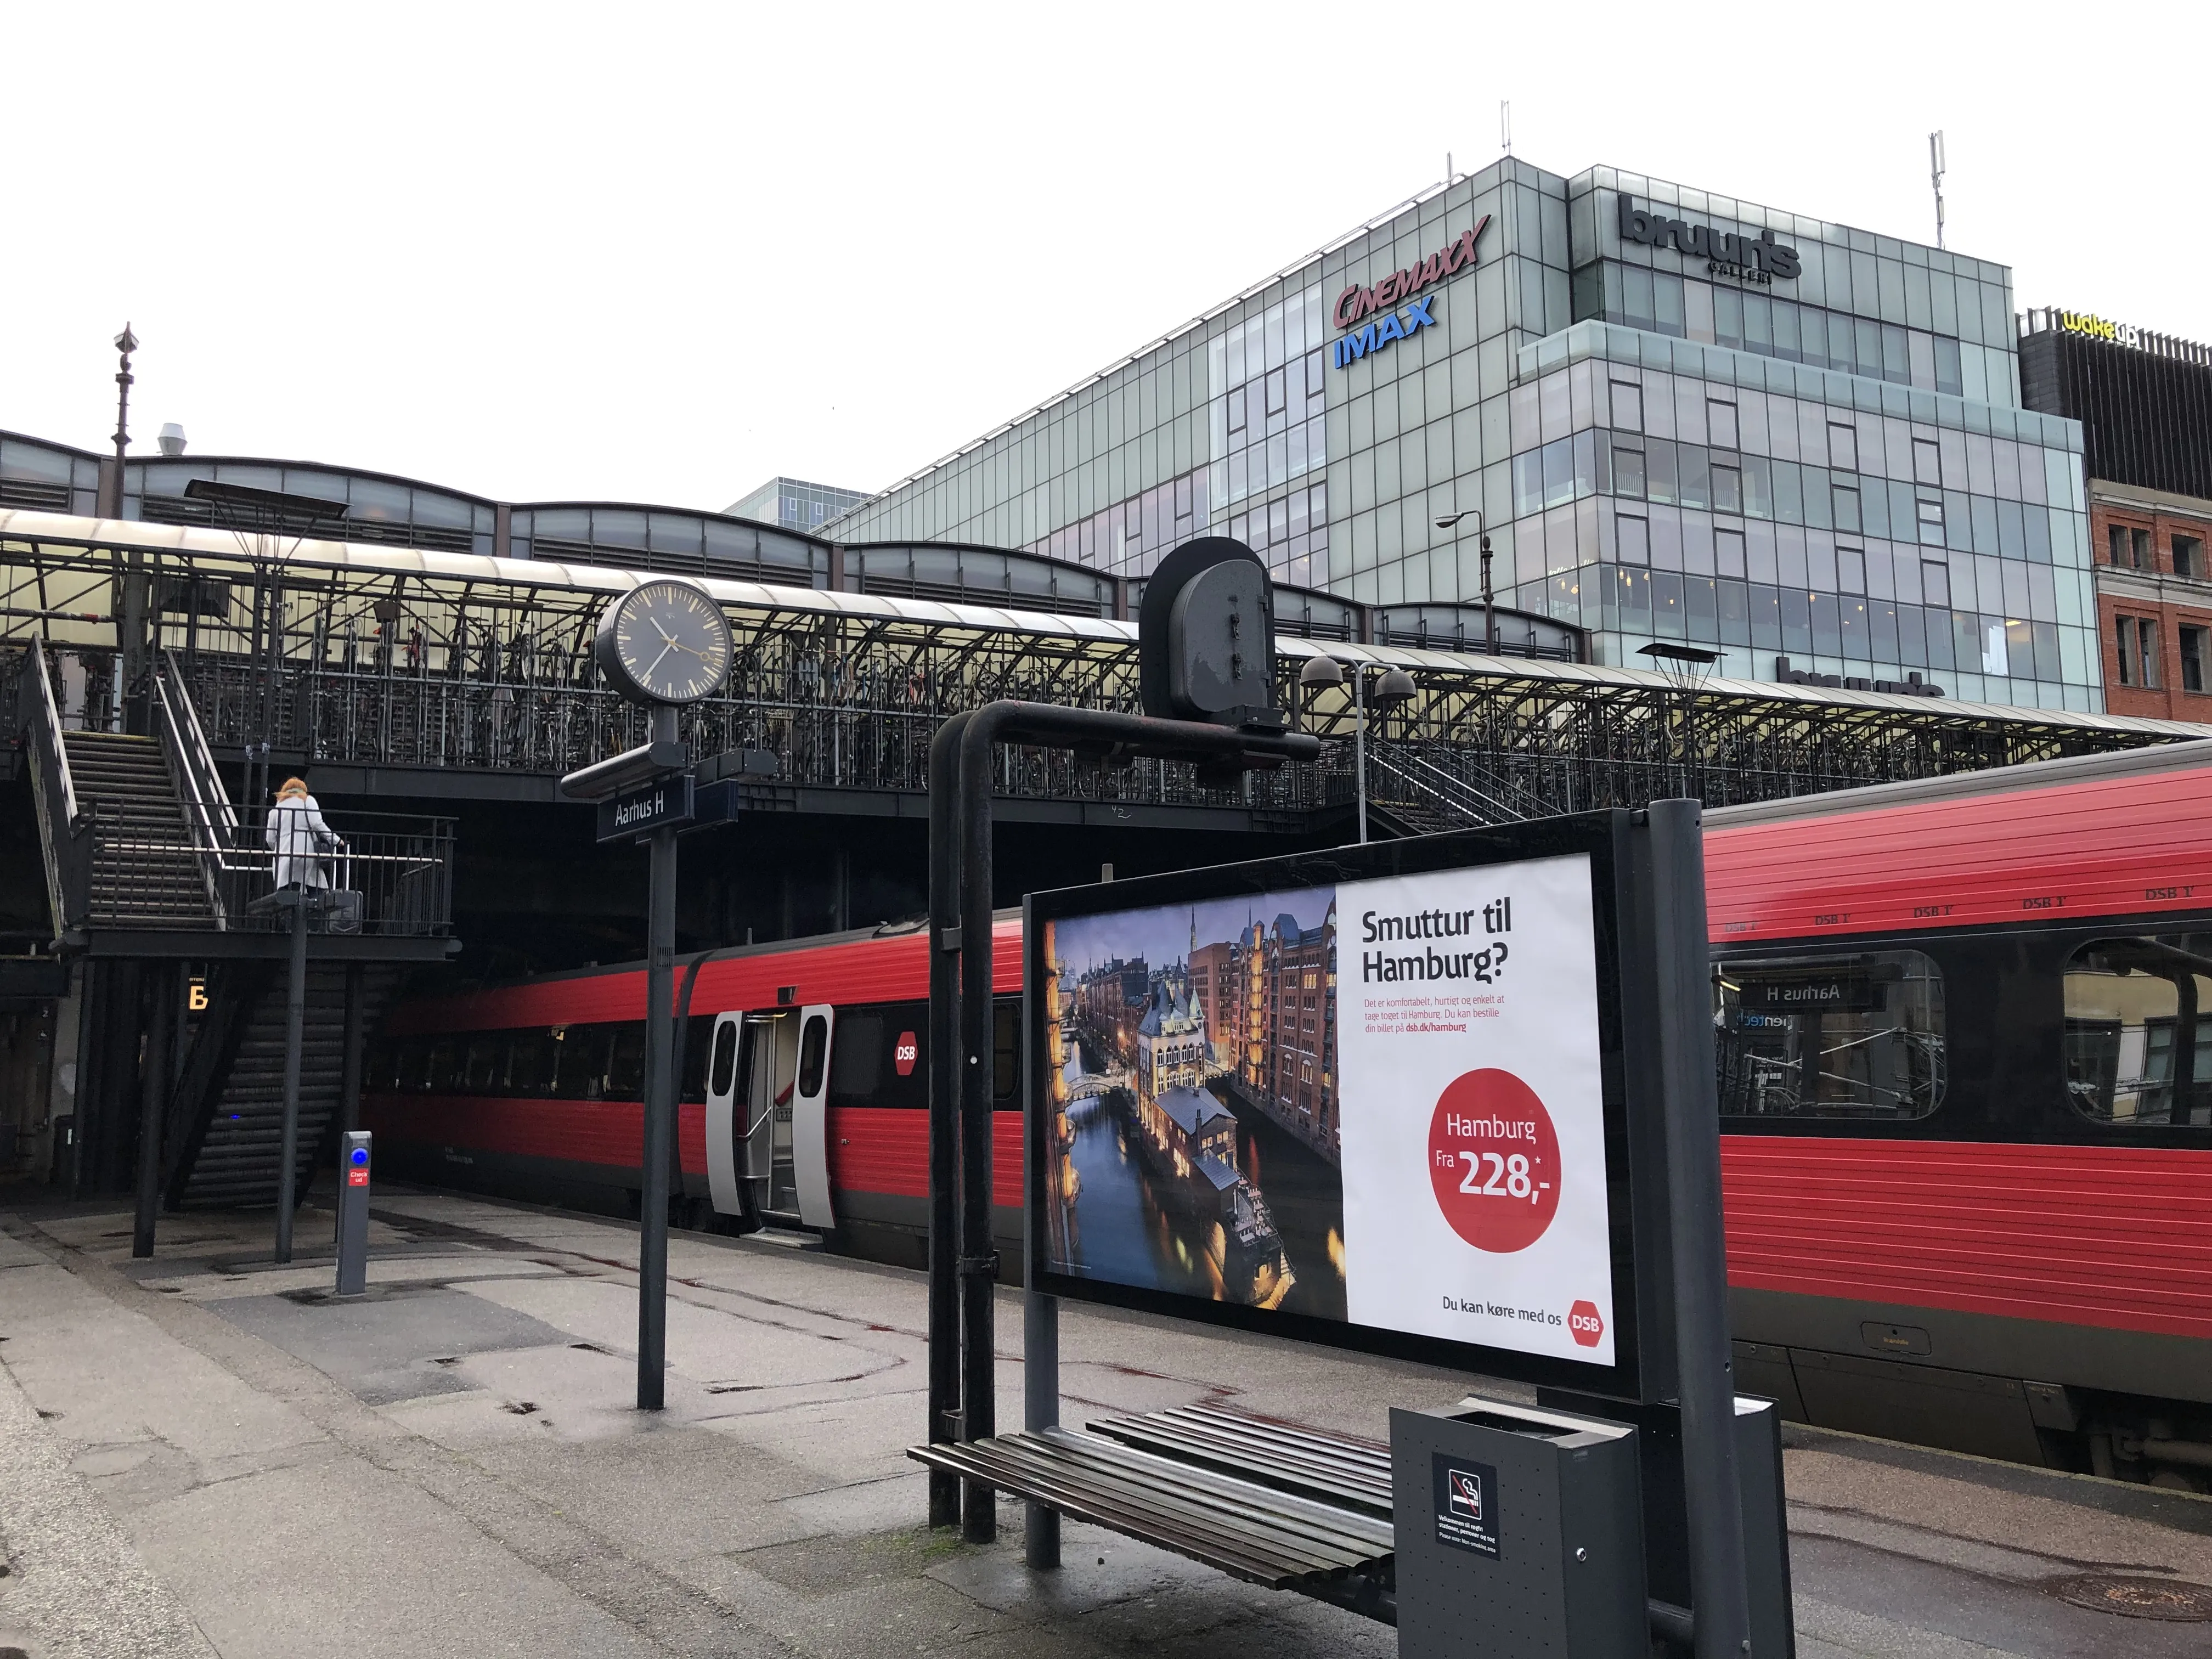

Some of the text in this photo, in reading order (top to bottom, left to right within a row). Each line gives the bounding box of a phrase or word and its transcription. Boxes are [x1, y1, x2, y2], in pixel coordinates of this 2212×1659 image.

[1333, 295, 1436, 369] IMAX
[615, 790, 664, 827] Aarhus H
[2145, 887, 2177, 900] DSB
[2023, 896, 2052, 910] DSB
[1362, 896, 1511, 943] Smuttur til
[1914, 906, 1939, 918] DSB
[1725, 922, 1746, 932] DSB
[1815, 914, 1838, 926] DSB
[1363, 941, 1509, 985] Hamburg?
[1364, 999, 1376, 1008] Det
[1386, 996, 1432, 1007] komfortabelt,
[1435, 996, 1459, 1007] hurtigt
[1462, 997, 1471, 1006] og
[1472, 994, 1495, 1005] enkelt
[1497, 995, 1505, 1003] at
[1365, 1012, 1379, 1022] tage
[1381, 1012, 1399, 1022] toget
[1409, 1009, 1442, 1020] Hamburg.
[1444, 1009, 1455, 1018] Du
[1457, 1008, 1471, 1018] kan
[1473, 1008, 1499, 1018] bestille
[1365, 1022, 1466, 1034] din billet på dsb.dk/hamburg
[896, 1046, 916, 1060] DSB
[1447, 1113, 1536, 1145] Hamburg
[1436, 1149, 1454, 1168] Fra
[1443, 1296, 1562, 1327] Du kan køre med os
[1572, 1315, 1600, 1333] DSB
[1438, 1514, 1464, 1527] Velkommen
[1439, 1522, 1459, 1533] stationer,
[1460, 1528, 1480, 1538] perroner
[1439, 1532, 1451, 1540] Please
[1462, 1538, 1487, 1551] Non-smoking
